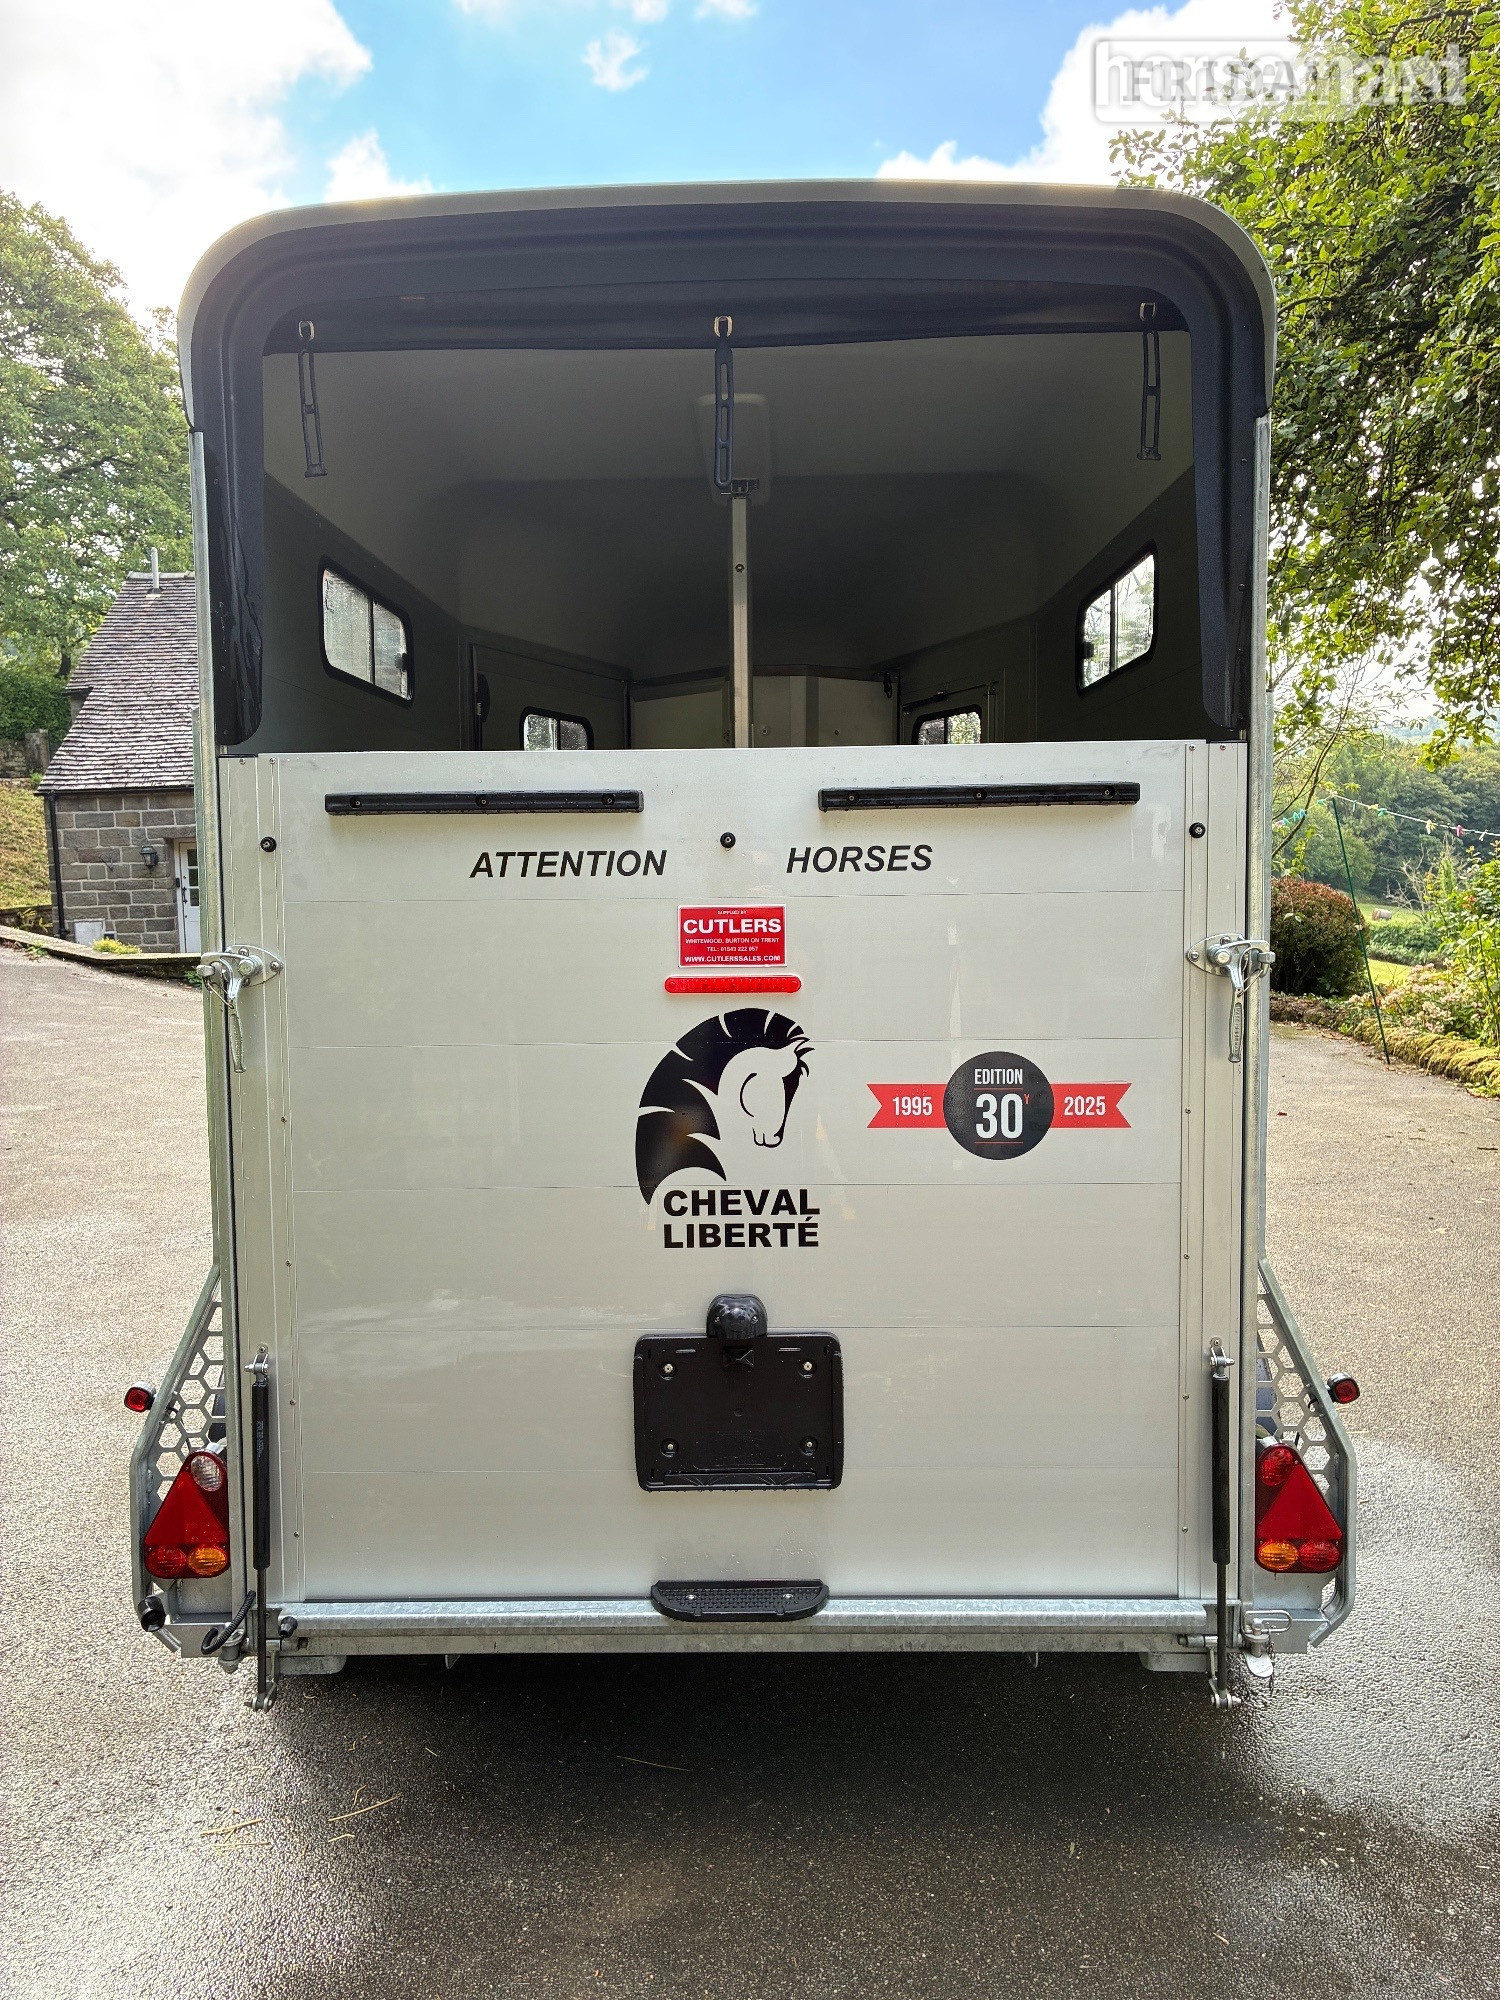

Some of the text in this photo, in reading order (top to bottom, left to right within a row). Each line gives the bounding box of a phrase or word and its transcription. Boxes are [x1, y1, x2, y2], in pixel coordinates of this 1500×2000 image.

[469, 844, 933, 879] ATTENTION HORSES
[683, 918, 782, 934] CUTLERS
[685, 955, 781, 963] WWW.CUTLERSSALES.COM
[974, 1068, 1023, 1085] EDITION
[892, 1096, 933, 1116] 1995
[1063, 1095, 1106, 1116] 2025
[663, 1188, 821, 1217] CHEVAL
[663, 1216, 820, 1249] LIBERTÉ
